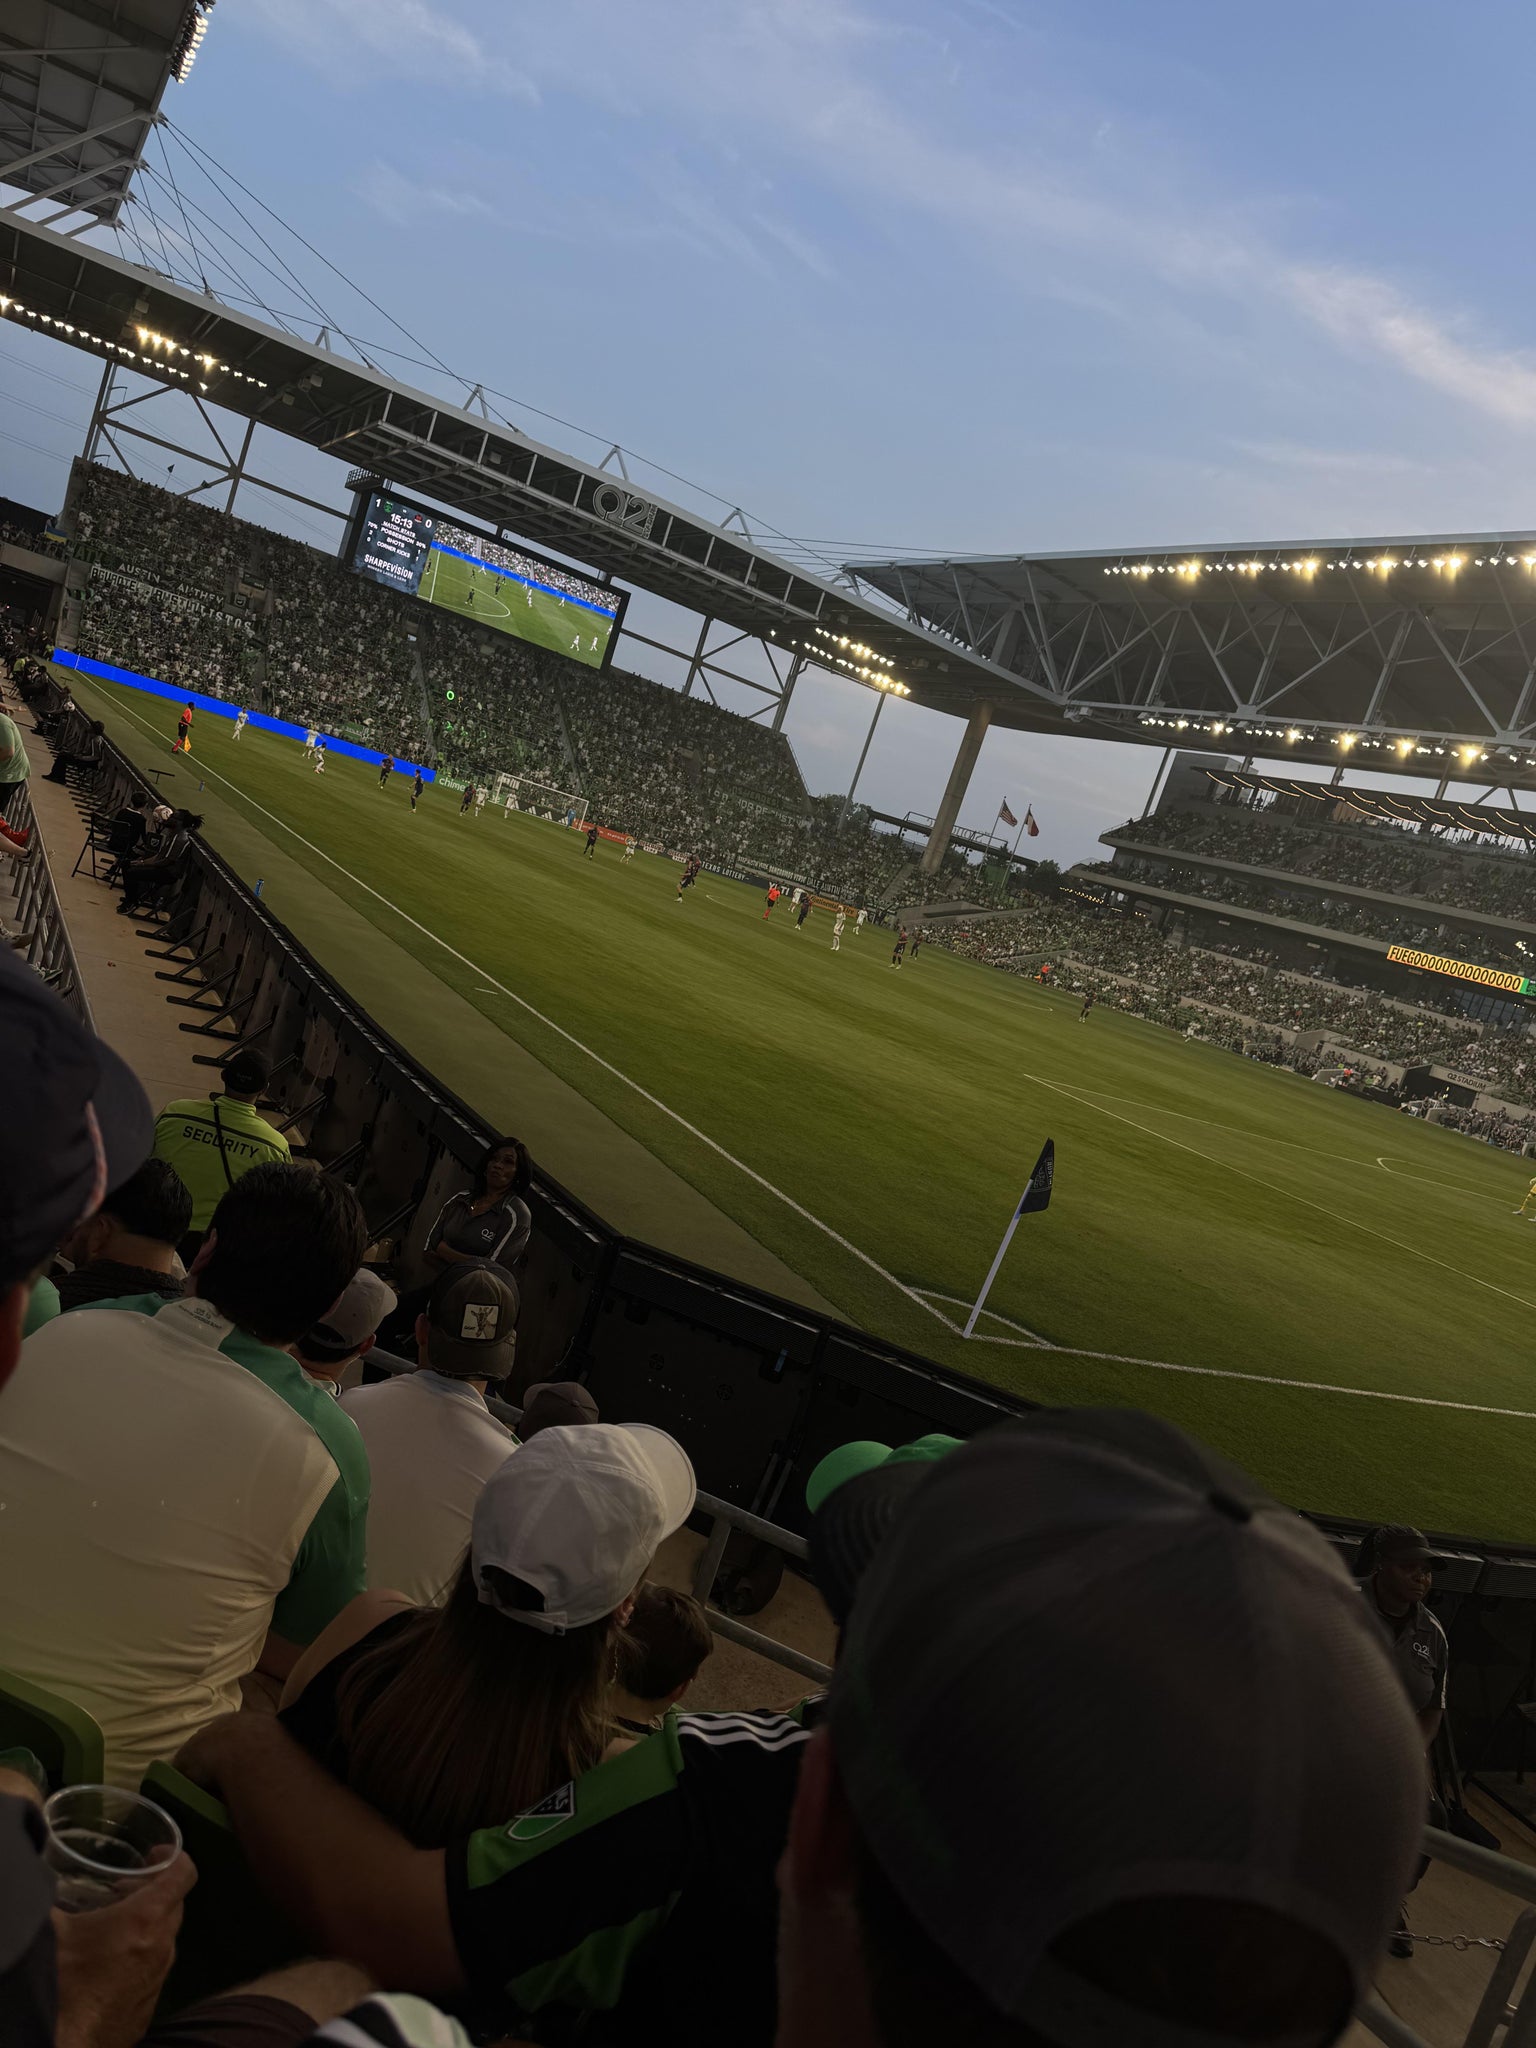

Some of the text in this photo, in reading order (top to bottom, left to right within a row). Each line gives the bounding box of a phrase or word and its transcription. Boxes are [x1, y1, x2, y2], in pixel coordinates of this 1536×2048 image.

[438, 776, 466, 792] chime
[701, 861, 721, 873] TEXAS
[183, 1126, 260, 1158] SECURITY
